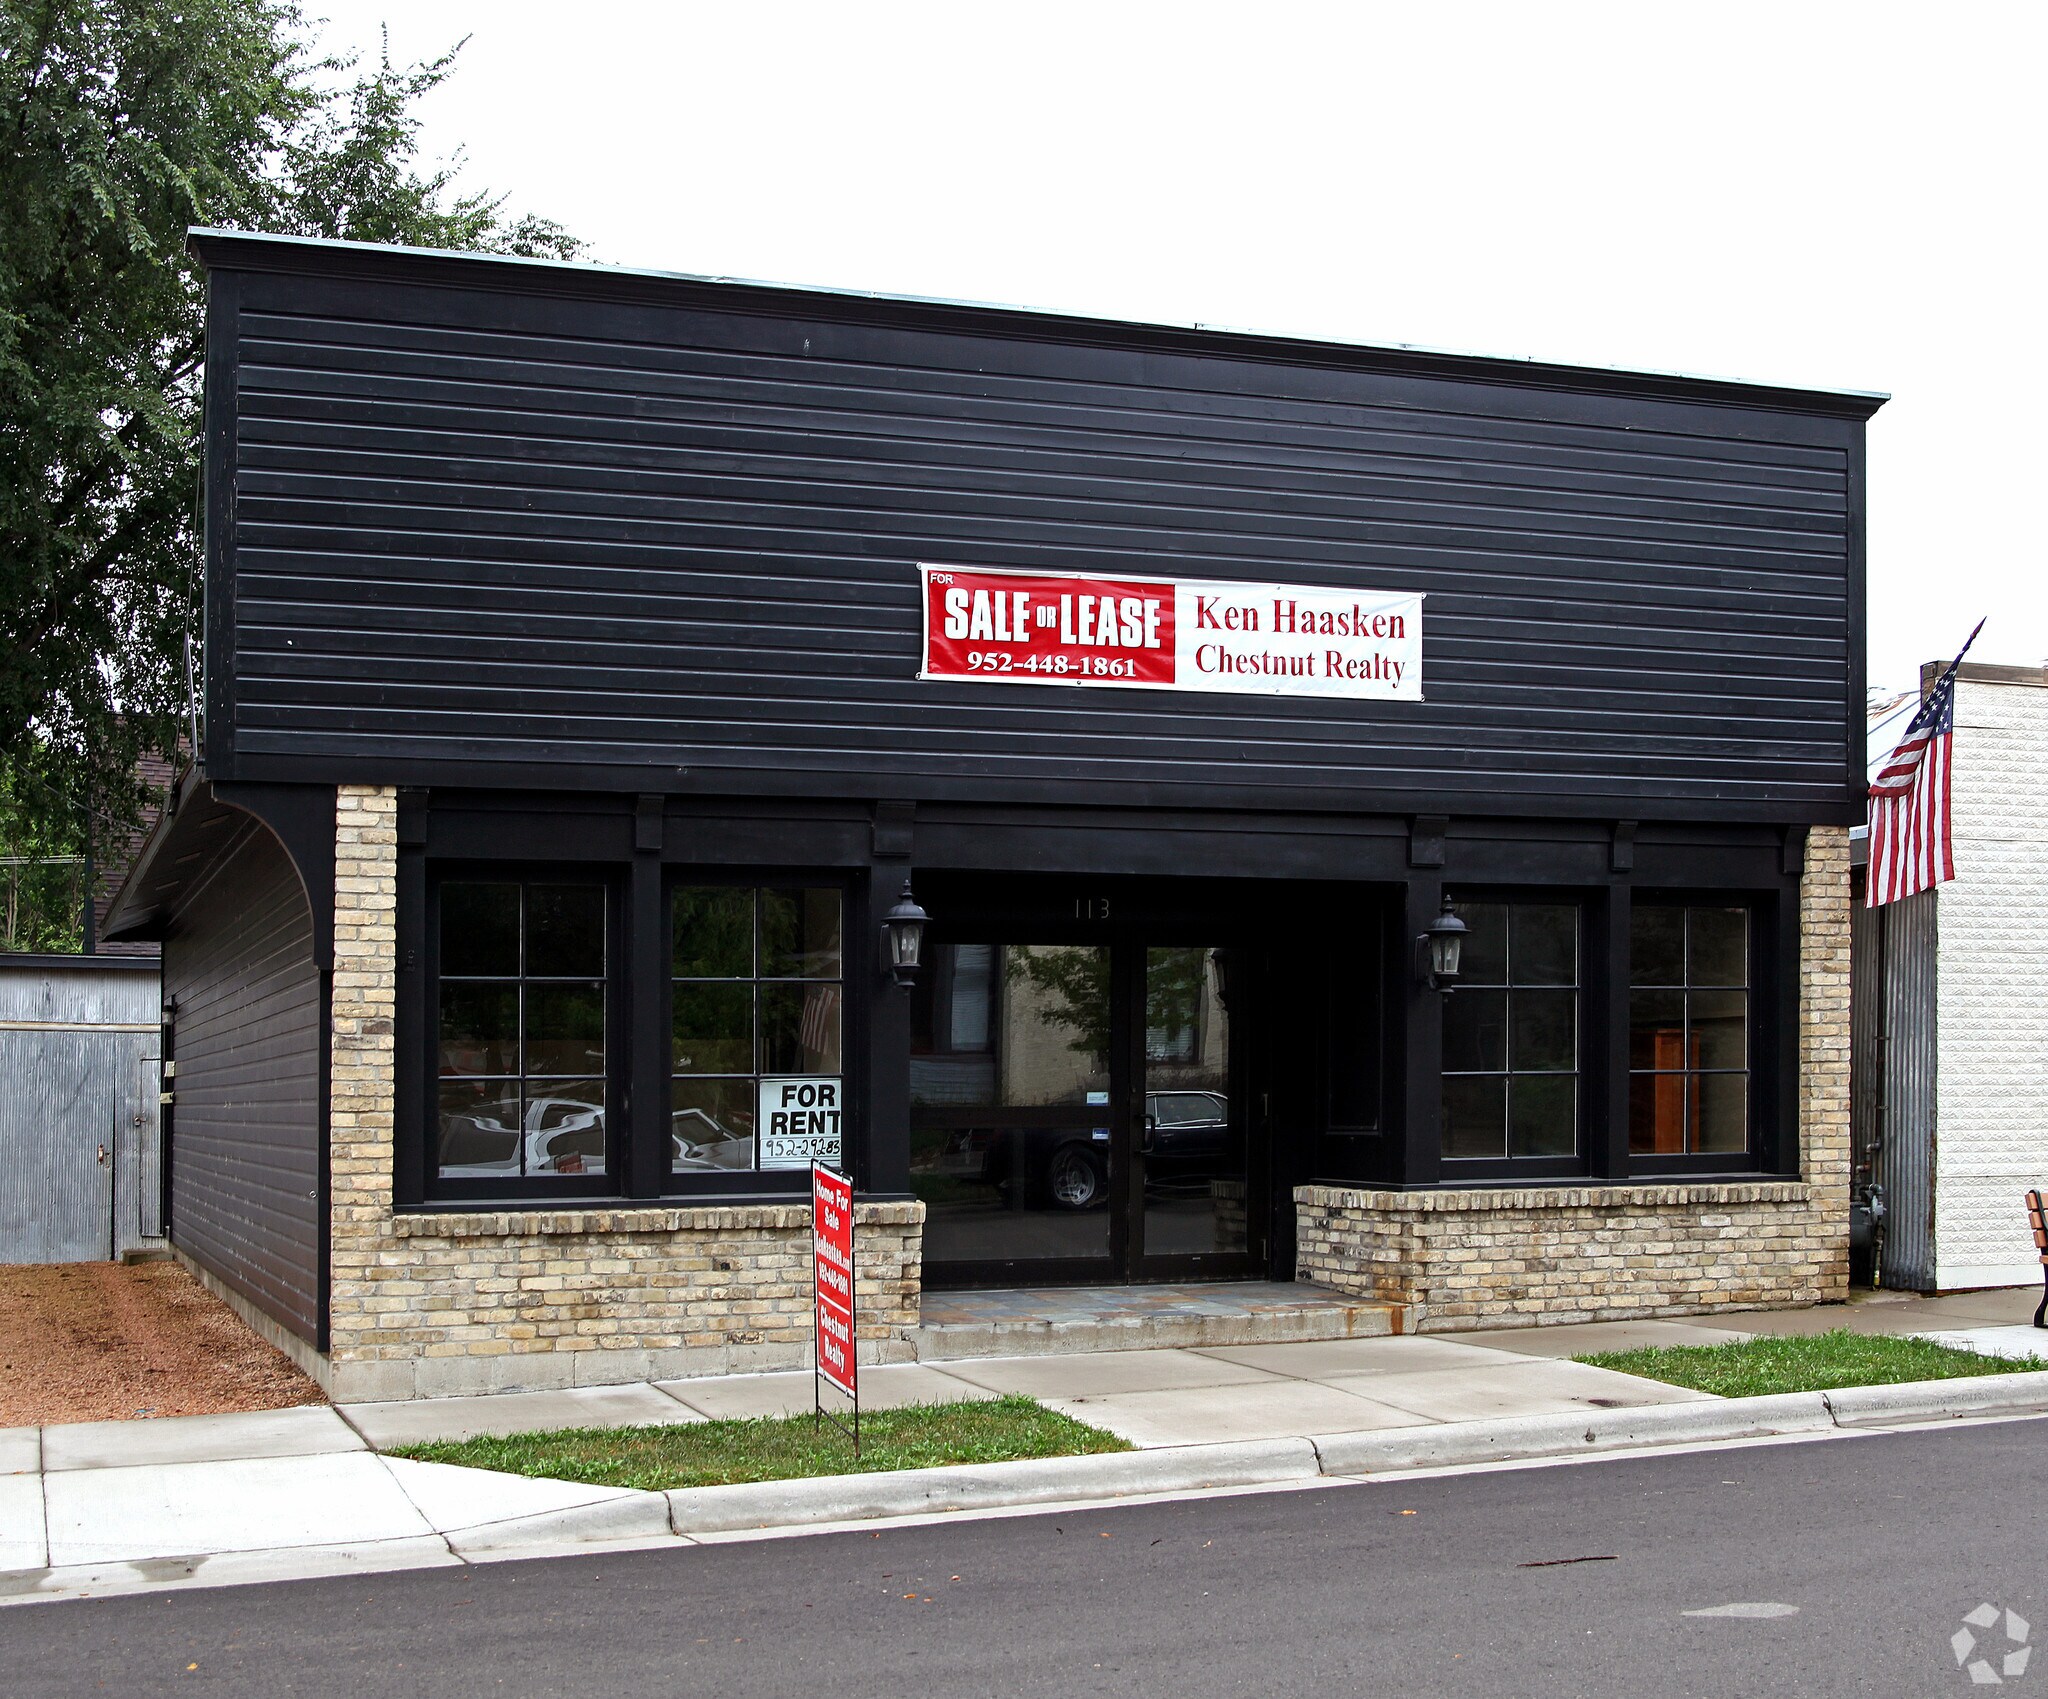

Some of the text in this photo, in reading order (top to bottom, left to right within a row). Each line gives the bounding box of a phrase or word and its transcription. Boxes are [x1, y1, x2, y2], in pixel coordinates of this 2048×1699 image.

[930, 573, 954, 584] FOR
[945, 588, 1161, 648] SALE OR LEASE
[1194, 595, 1406, 639] Ken Haasken
[967, 651, 1136, 677] 952-448-1861
[1195, 643, 1406, 689] Chestnut Realty
[1076, 899, 1109, 918] 113
[781, 1084, 836, 1108] FOR
[770, 1110, 840, 1135] RENT
[816, 1178, 849, 1212] Home For
[824, 1205, 840, 1231] Sale
[820, 1304, 849, 1344] Chestnut
[824, 1334, 845, 1374] Realty
